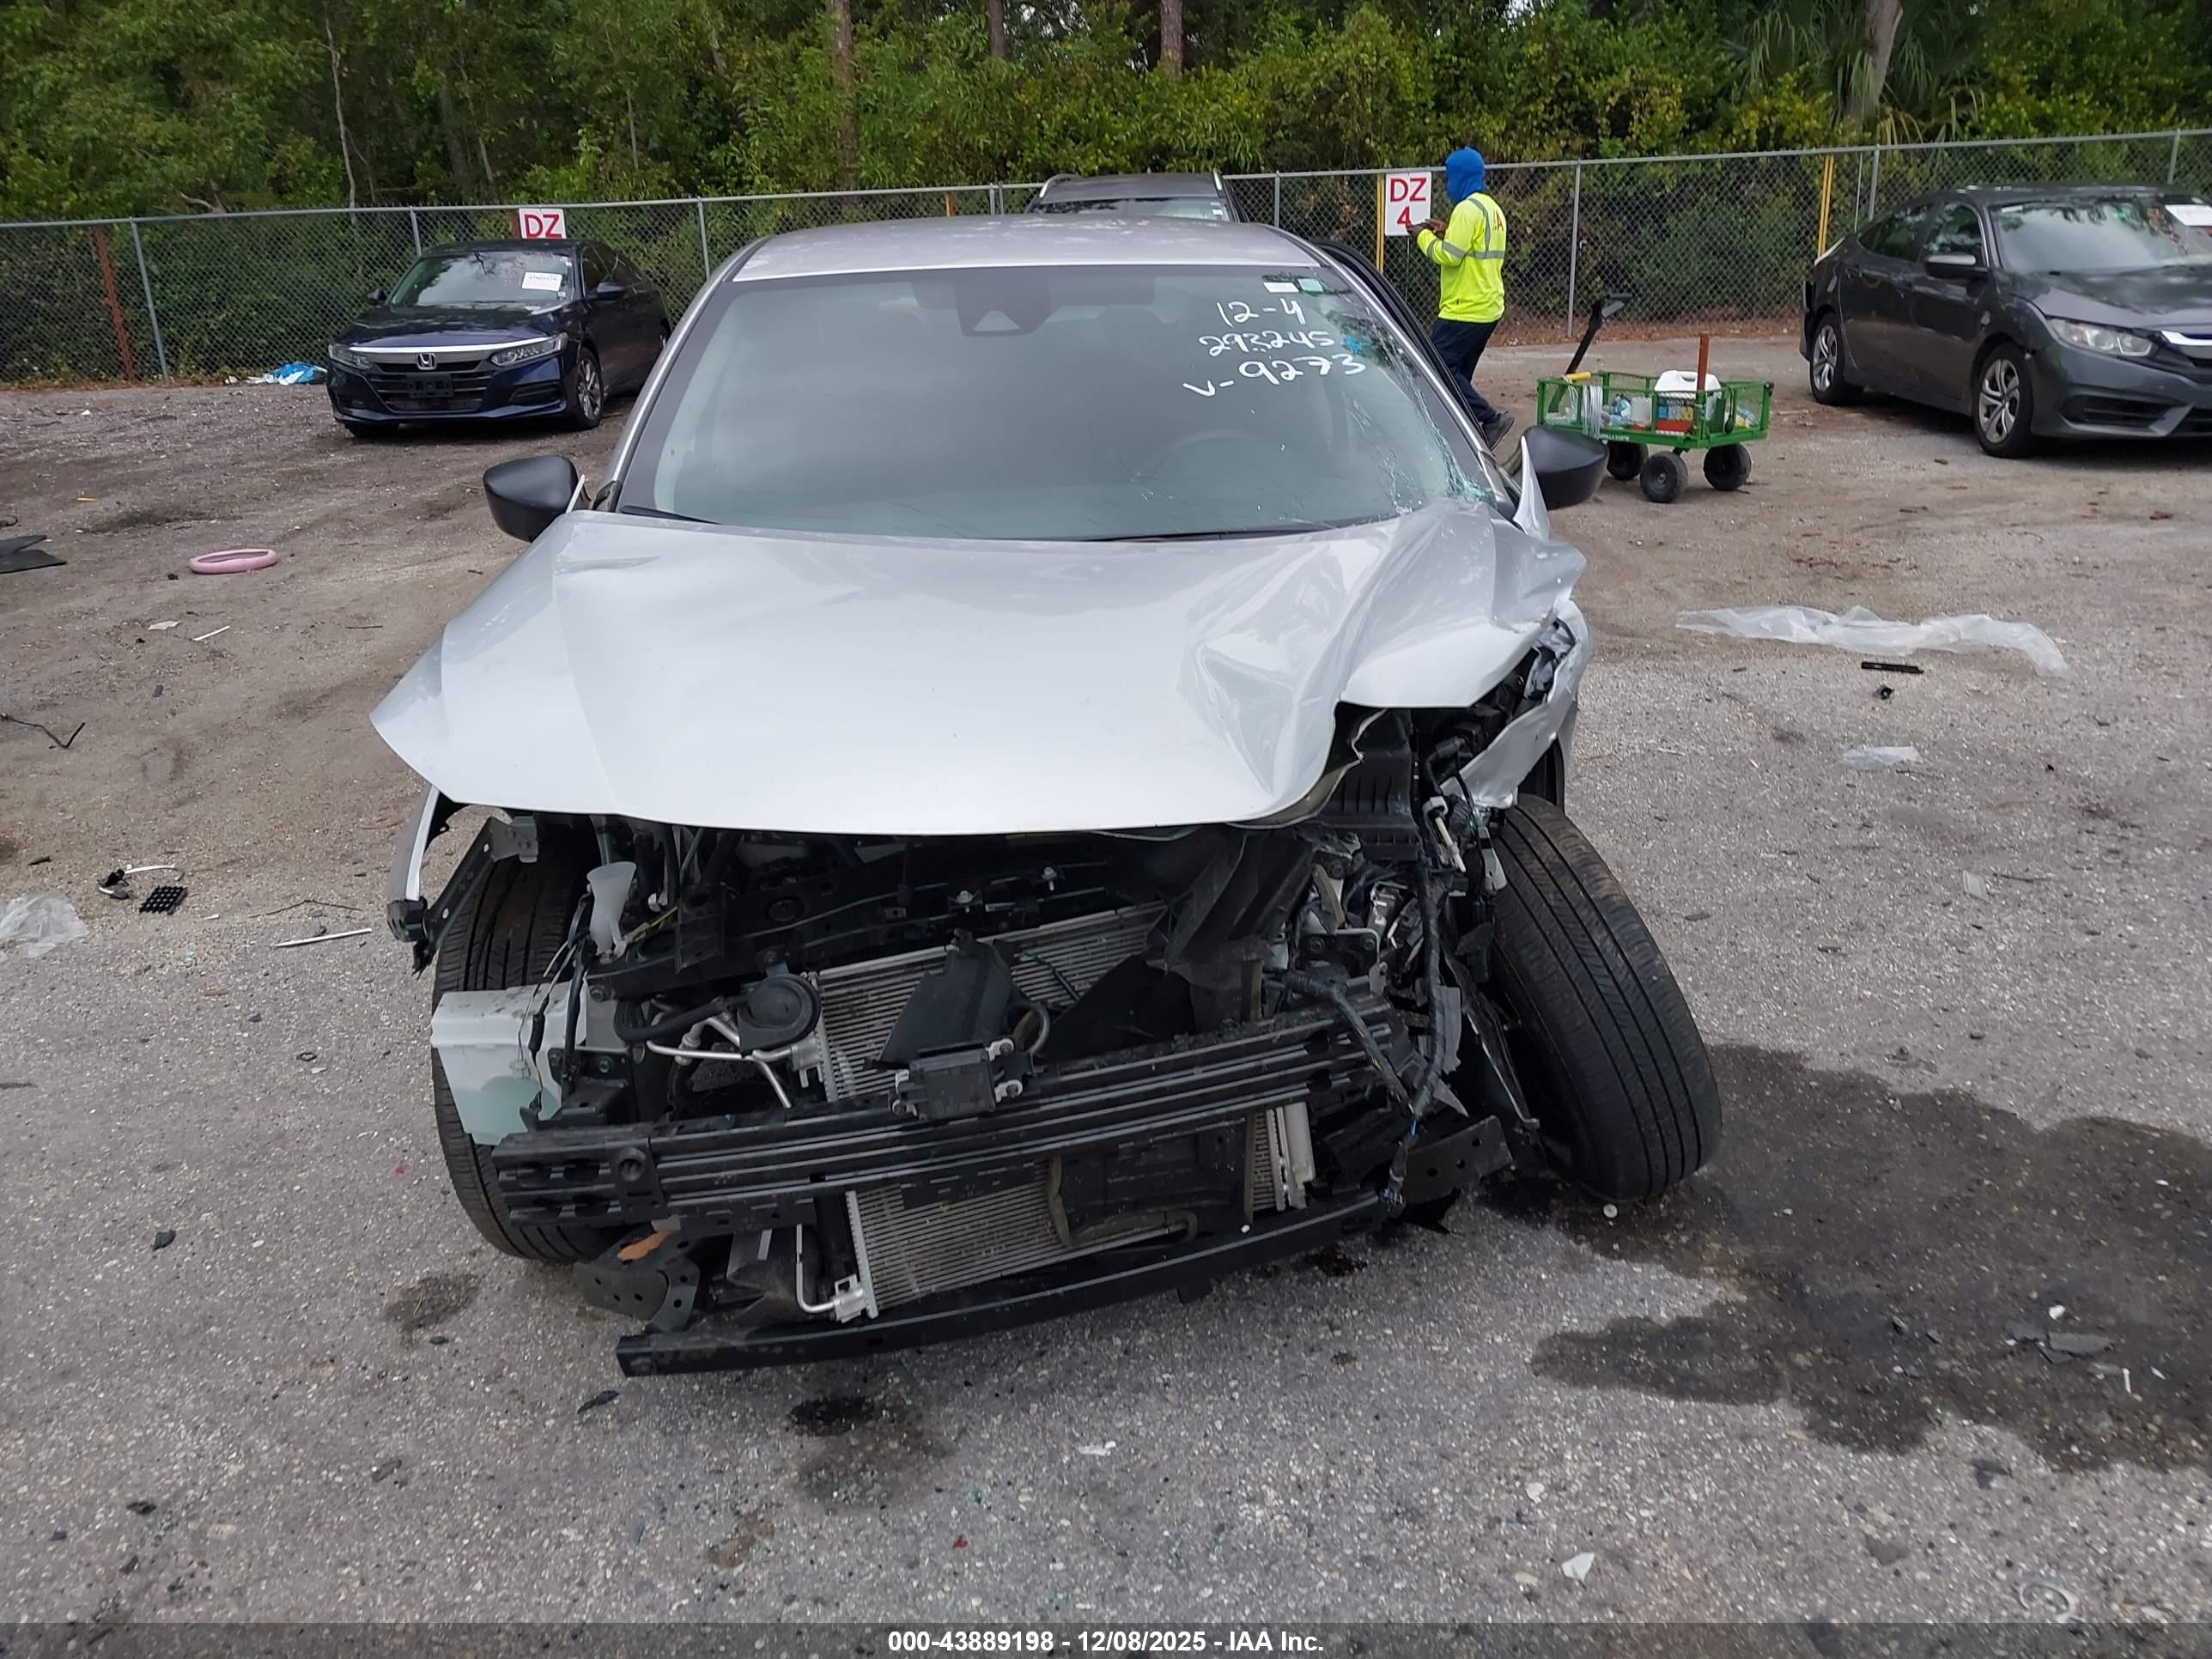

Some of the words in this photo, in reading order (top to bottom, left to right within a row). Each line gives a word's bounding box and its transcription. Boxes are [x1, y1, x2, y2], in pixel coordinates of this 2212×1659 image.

[1389, 177, 1427, 203] DZ
[524, 214, 563, 239] DZ
[1396, 205, 1412, 228] 4
[1216, 297, 1306, 327] 12-4
[1198, 330, 1334, 357] 293245
